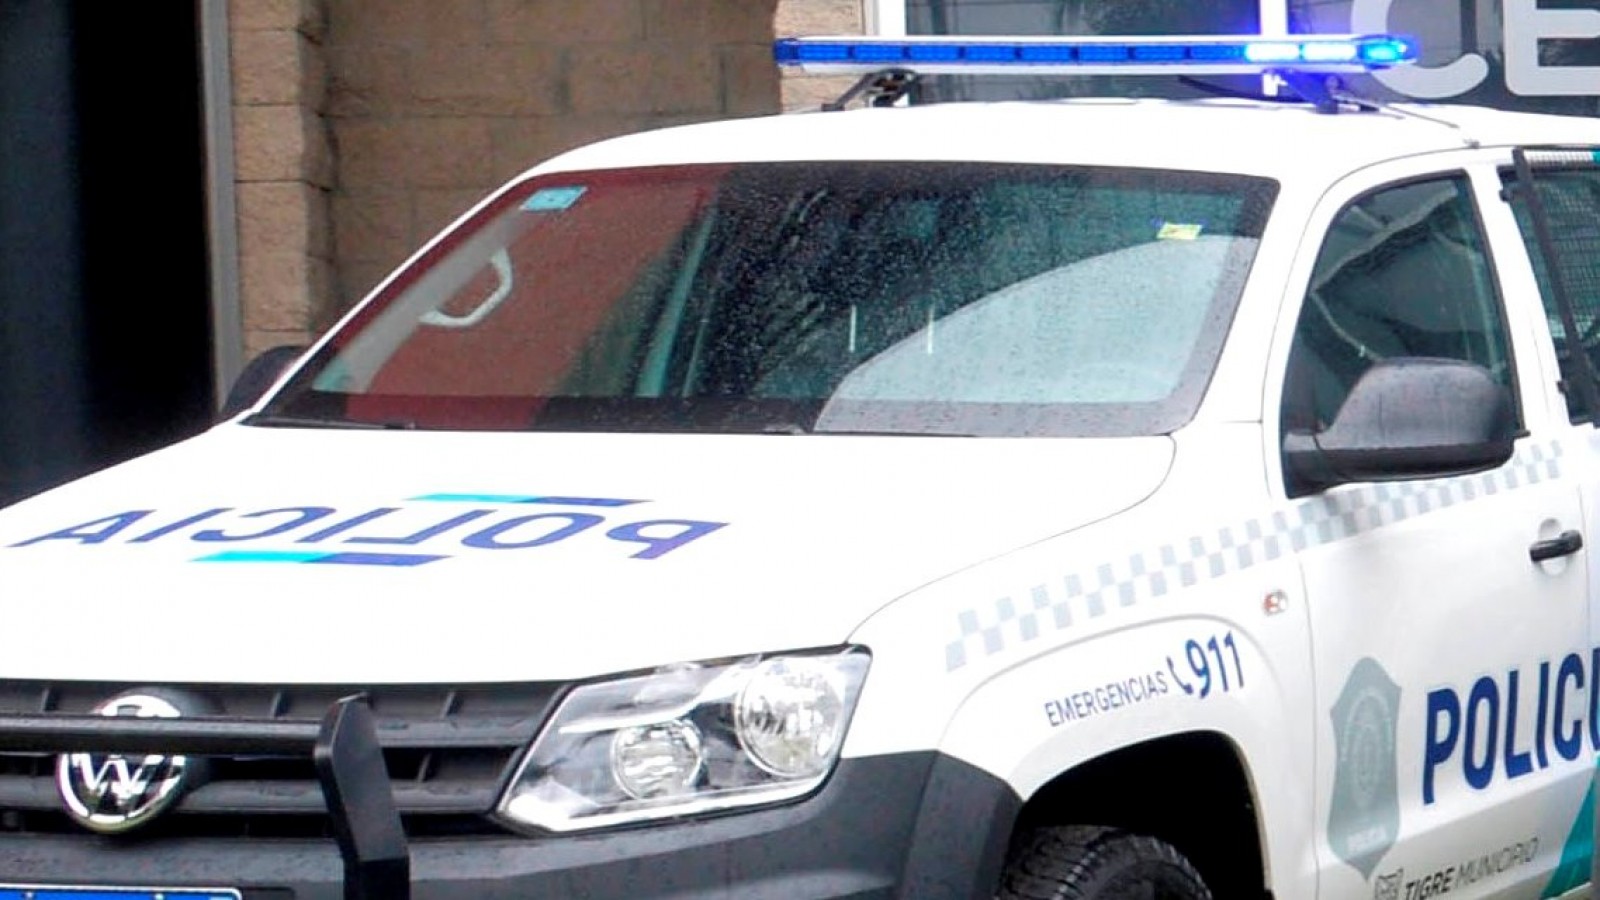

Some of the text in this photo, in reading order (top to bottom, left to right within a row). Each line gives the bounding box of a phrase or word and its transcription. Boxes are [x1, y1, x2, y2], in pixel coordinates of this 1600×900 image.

[1045, 630, 1244, 727] EMERGENCIAS 911
[1405, 866, 1455, 900] TIGRE
